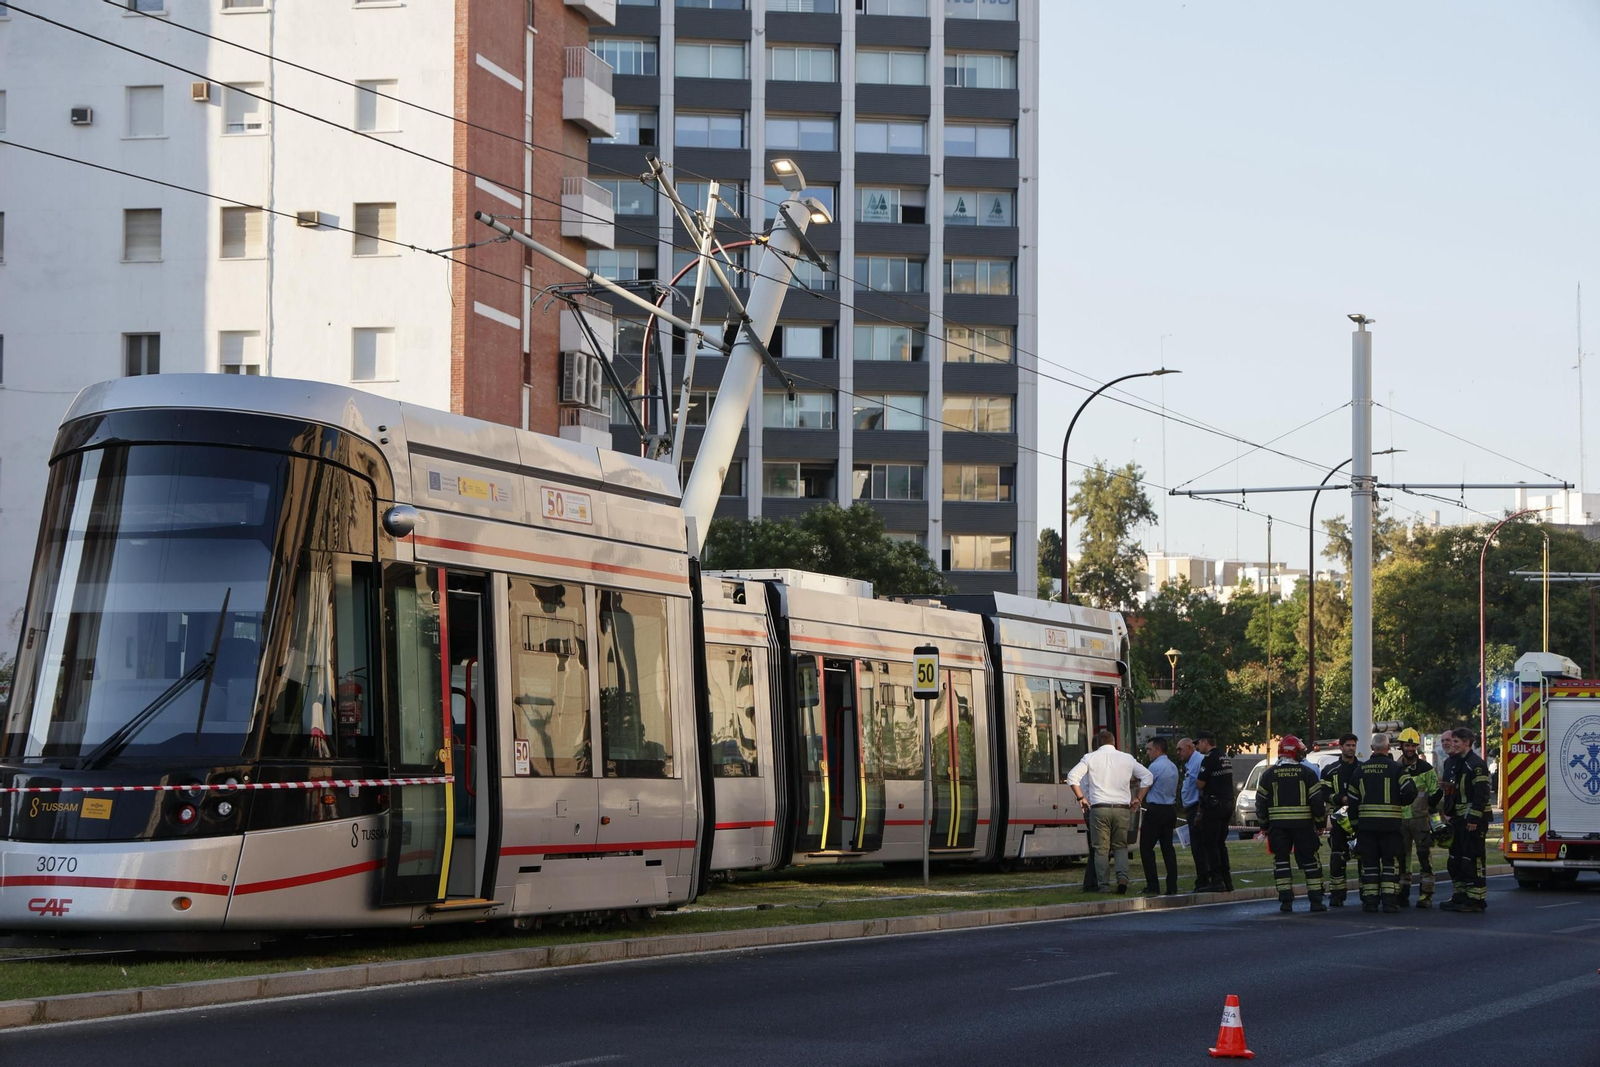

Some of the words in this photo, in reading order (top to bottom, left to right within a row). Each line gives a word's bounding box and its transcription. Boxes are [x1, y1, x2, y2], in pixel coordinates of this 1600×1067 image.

[547, 490, 564, 517] 50
[918, 663, 934, 683] 50
[516, 742, 528, 761] 50
[1511, 744, 1541, 753] BUL-14
[1574, 772, 1588, 780] NO
[41, 802, 78, 812] TUSSAM
[1517, 832, 1532, 840] LDL
[36, 856, 78, 873] 3070
[27, 898, 73, 916] CAF
